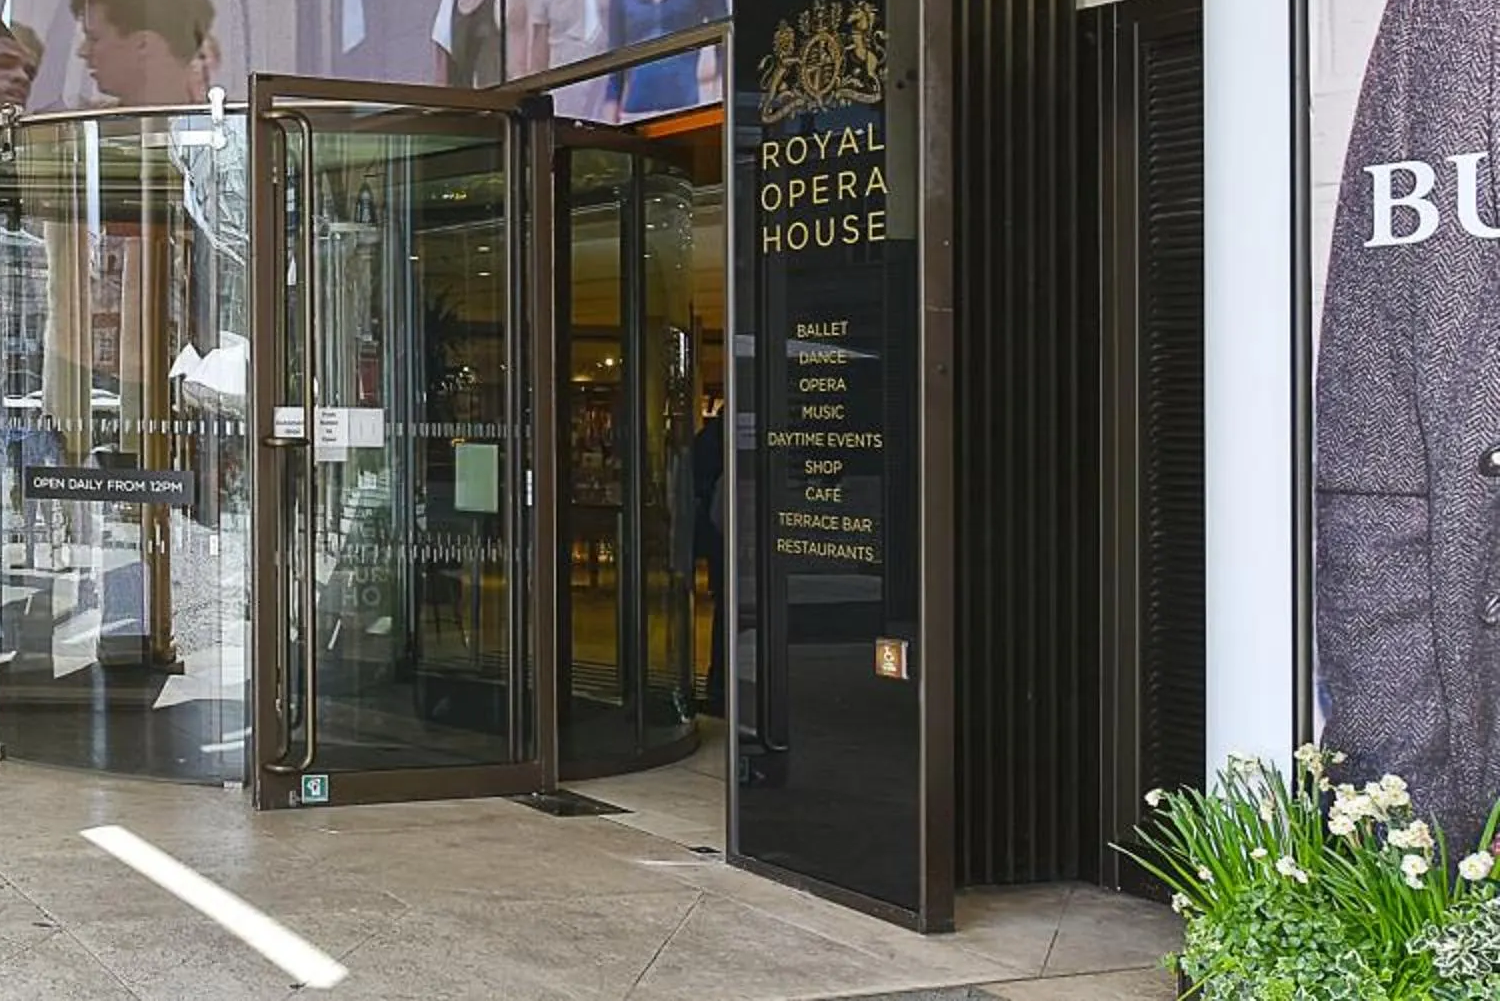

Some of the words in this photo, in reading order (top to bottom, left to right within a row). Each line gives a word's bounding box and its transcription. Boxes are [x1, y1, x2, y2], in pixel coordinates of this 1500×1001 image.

[762, 122, 885, 170] ROYAL
[761, 166, 888, 211] OPERA
[763, 211, 886, 253] HOUSE
[797, 320, 849, 338] BALLET
[799, 350, 847, 365] DANCE
[799, 377, 847, 392] OPERA
[802, 404, 845, 419] MUSIC
[767, 432, 824, 446] DAYTIME
[827, 432, 883, 448] EVENTS
[804, 460, 843, 474] SHOP
[33, 477, 65, 488] OPEN
[68, 478, 103, 491] DAILY
[107, 479, 146, 492] FROM
[150, 481, 183, 493] 12PM
[779, 512, 839, 530] TERRACE
[842, 516, 873, 532] BAR
[777, 538, 875, 561] RESTAURANTS
